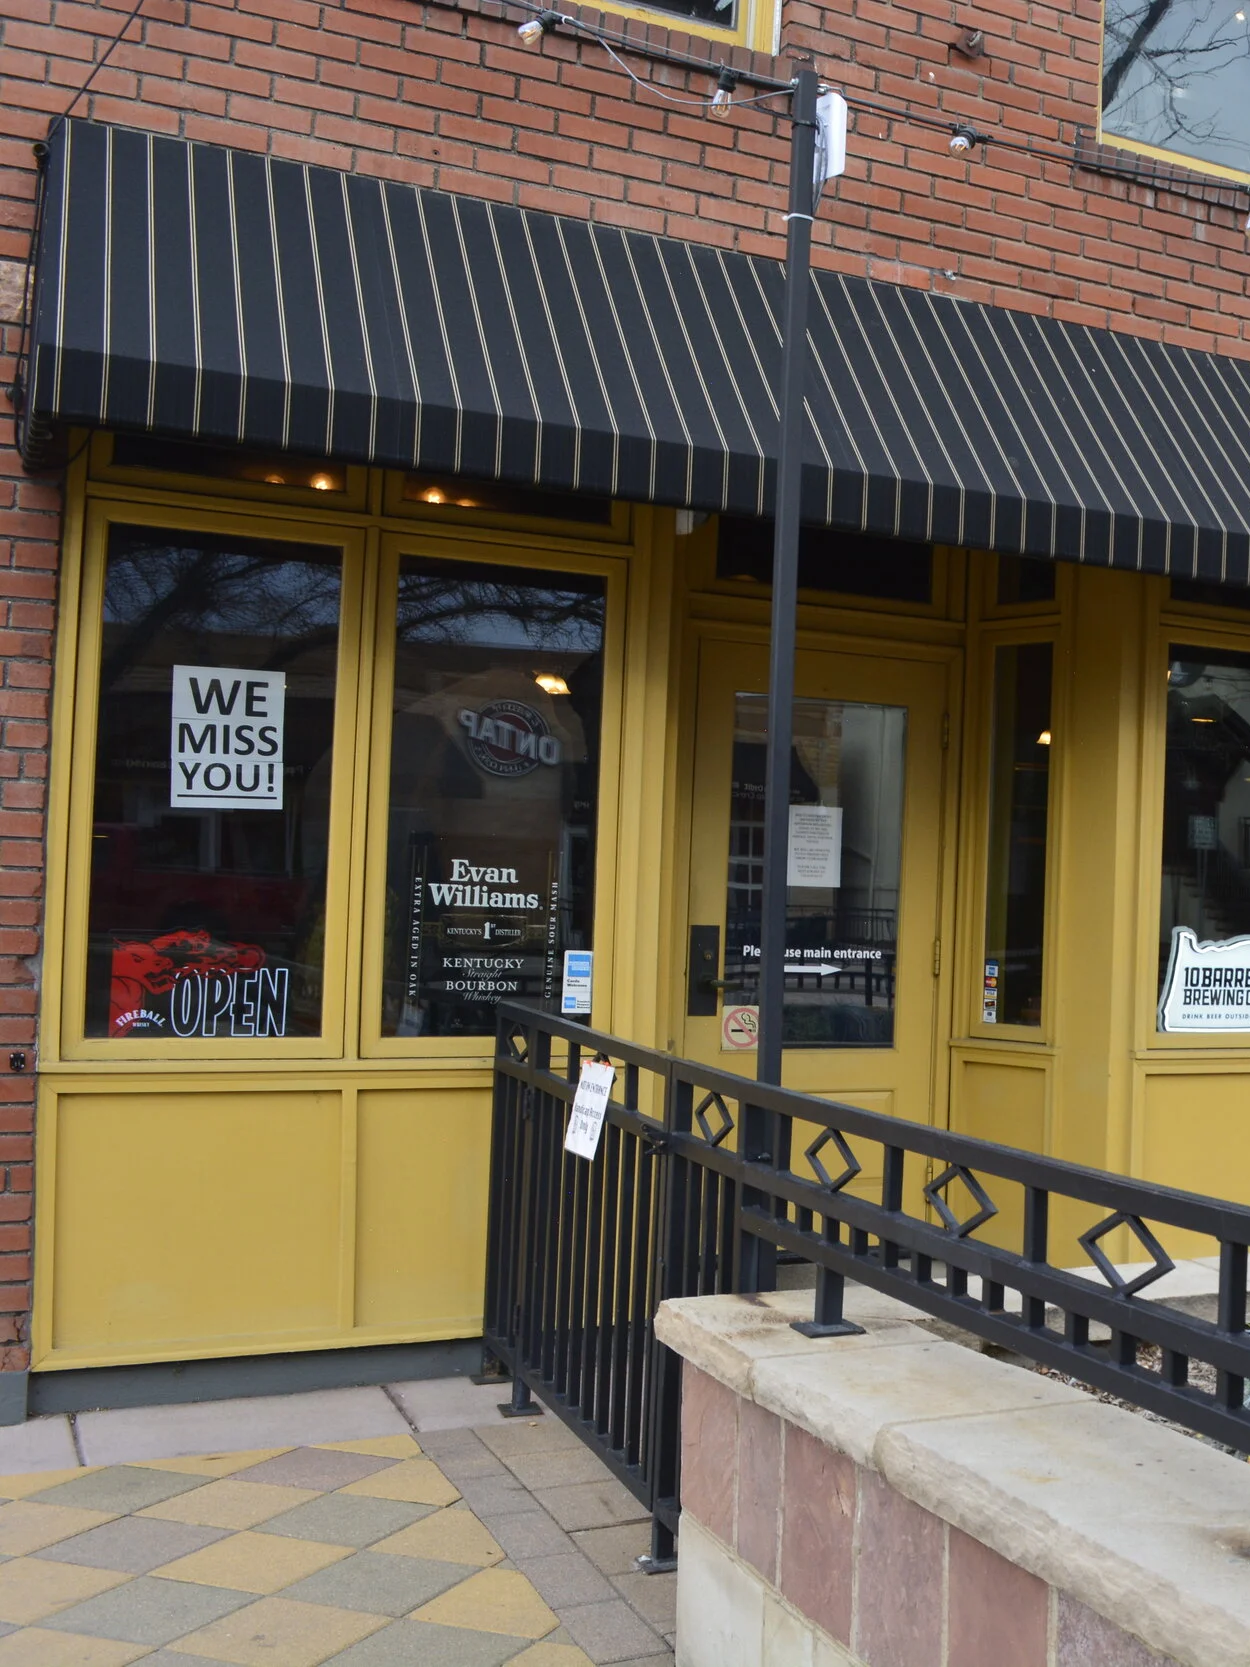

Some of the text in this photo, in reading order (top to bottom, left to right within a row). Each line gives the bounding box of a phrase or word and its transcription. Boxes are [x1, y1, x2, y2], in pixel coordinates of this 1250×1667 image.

[189, 677, 270, 718] WE
[177, 723, 279, 756] MISS
[178, 762, 275, 793] YOU!
[450, 859, 518, 883] Evan
[428, 883, 539, 909] Williams
[408, 877, 423, 997] EXTRA AGED IN OAK
[544, 882, 559, 999] GENUINE SOUR MASH
[443, 957, 524, 969] KENTUCKY
[804, 947, 831, 958] main
[834, 948, 882, 959] entrance
[446, 980, 518, 991] BOURBON
[462, 968, 502, 981] Straight
[171, 966, 289, 1037] OPEN
[463, 991, 502, 1004] Whiskey
[1183, 988, 1244, 1006] BREWING
[115, 1008, 167, 1028] FIREBALL
